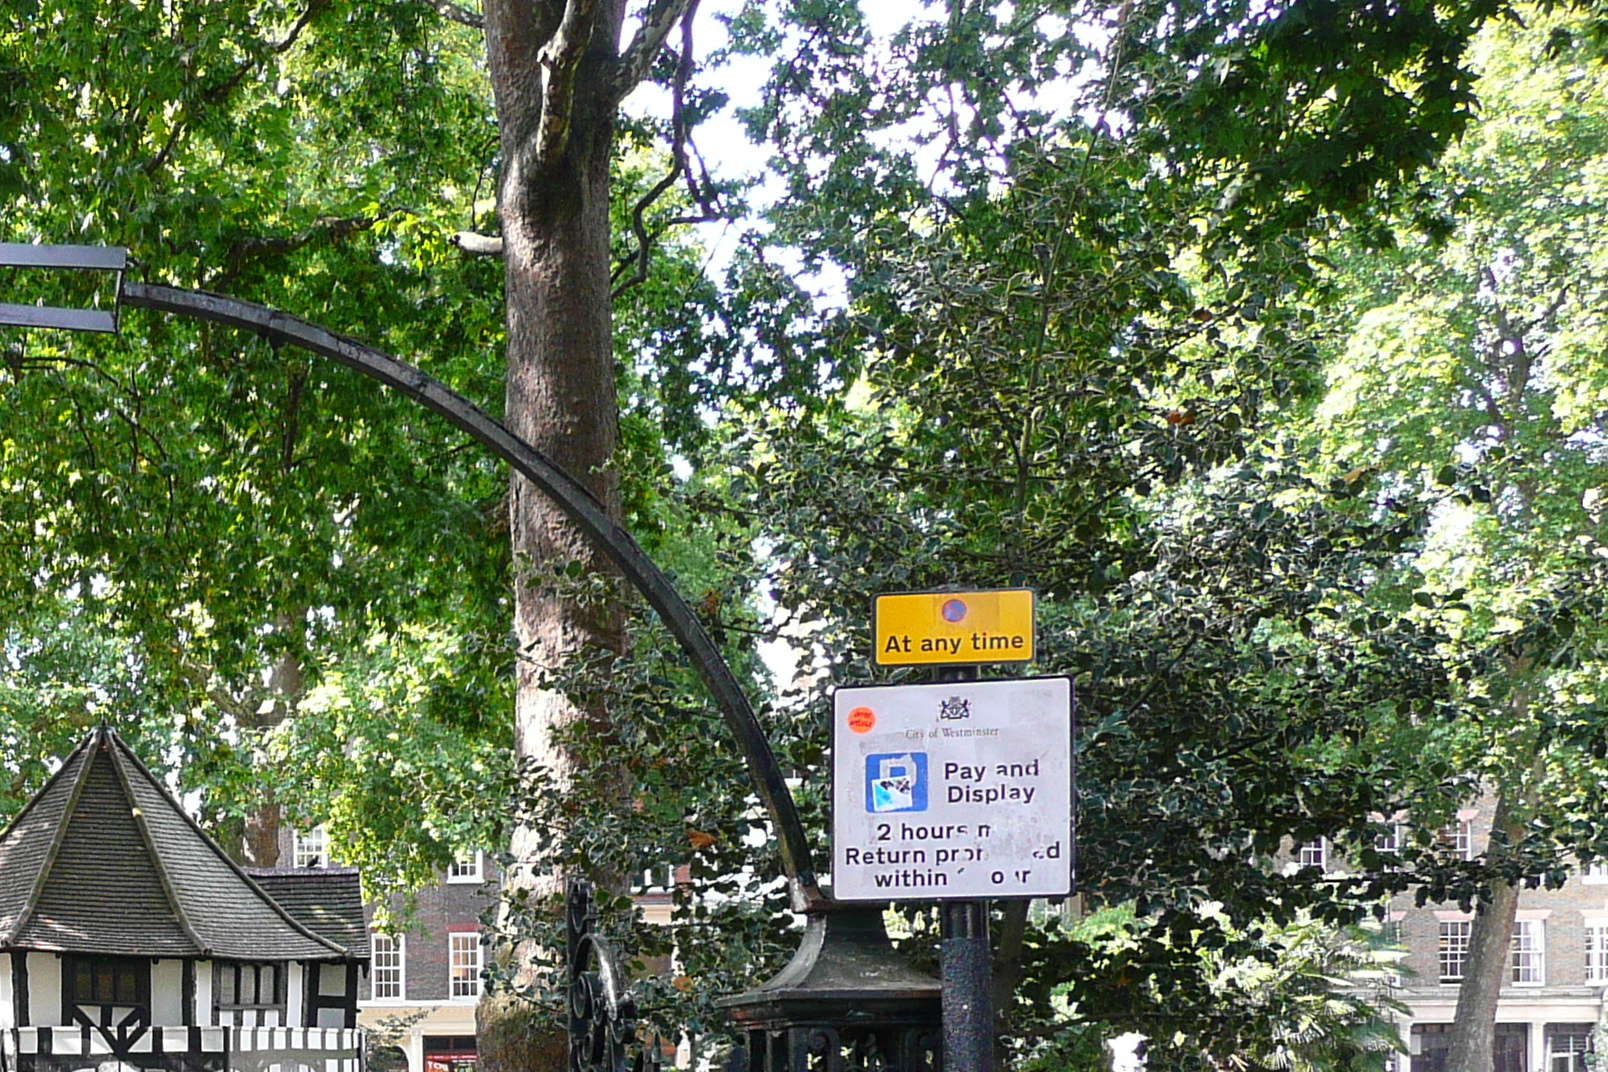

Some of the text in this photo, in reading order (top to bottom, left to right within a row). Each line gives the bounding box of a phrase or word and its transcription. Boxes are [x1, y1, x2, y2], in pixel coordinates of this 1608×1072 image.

[885, 632, 1024, 655] At any time
[905, 726, 1000, 740] City of Westminster
[944, 758, 1040, 783] Pay and
[947, 783, 1035, 805] Display
[876, 823, 891, 841] 2
[845, 847, 927, 866] Return
[874, 868, 948, 888] within
